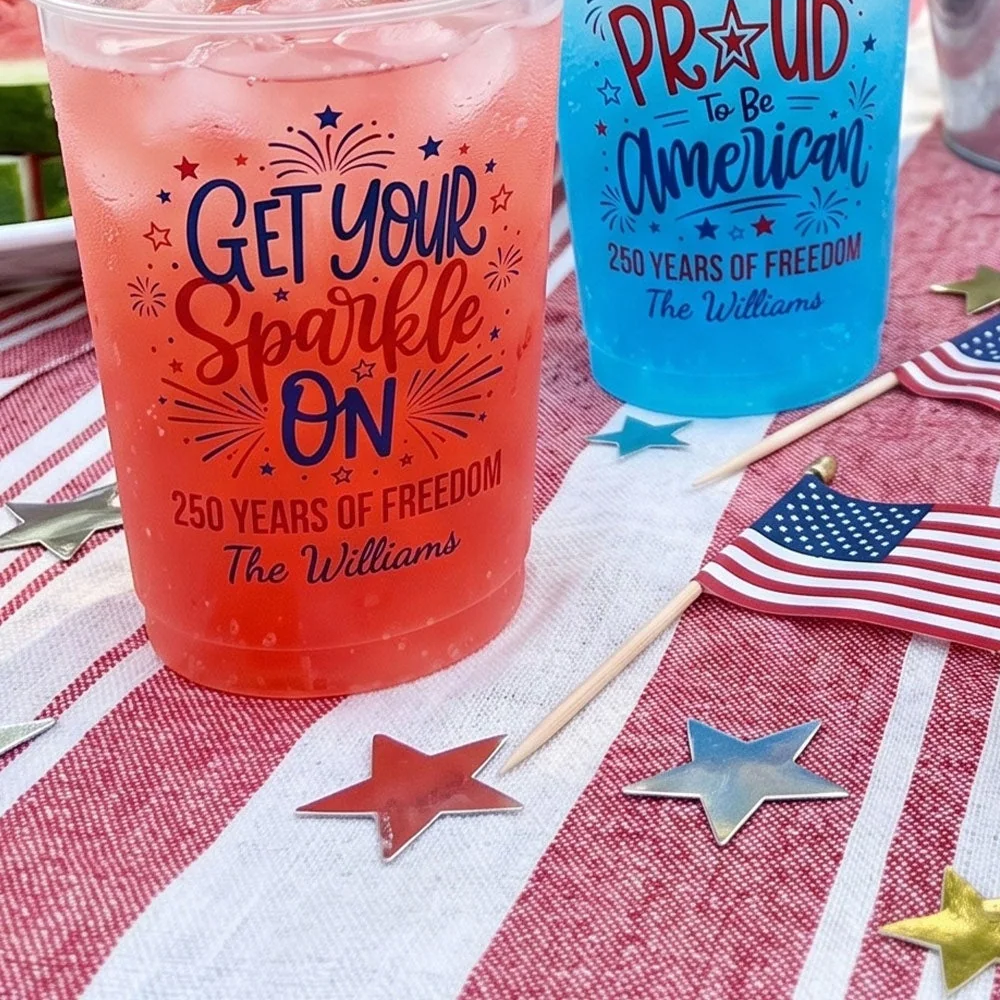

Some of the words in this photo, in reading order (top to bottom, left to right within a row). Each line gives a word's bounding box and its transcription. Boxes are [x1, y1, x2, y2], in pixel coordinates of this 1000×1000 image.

[698, 92, 734, 123] To
[740, 87, 774, 122] Be
[186, 179, 322, 292] GET
[331, 165, 486, 279] YOUR
[608, 243, 644, 277] 250
[649, 252, 722, 282] YEARS
[731, 252, 756, 280] OF
[765, 232, 861, 278] FREEDOM
[175, 258, 484, 401] Sparkle
[647, 288, 694, 321] The
[705, 288, 824, 322] Williams
[281, 370, 396, 466] ON
[171, 490, 224, 532] 250
[230, 498, 328, 534] YEARS
[337, 491, 372, 530] OF
[382, 450, 502, 523] FREEDOM
[224, 544, 287, 584] The
[301, 530, 461, 583] Williams
